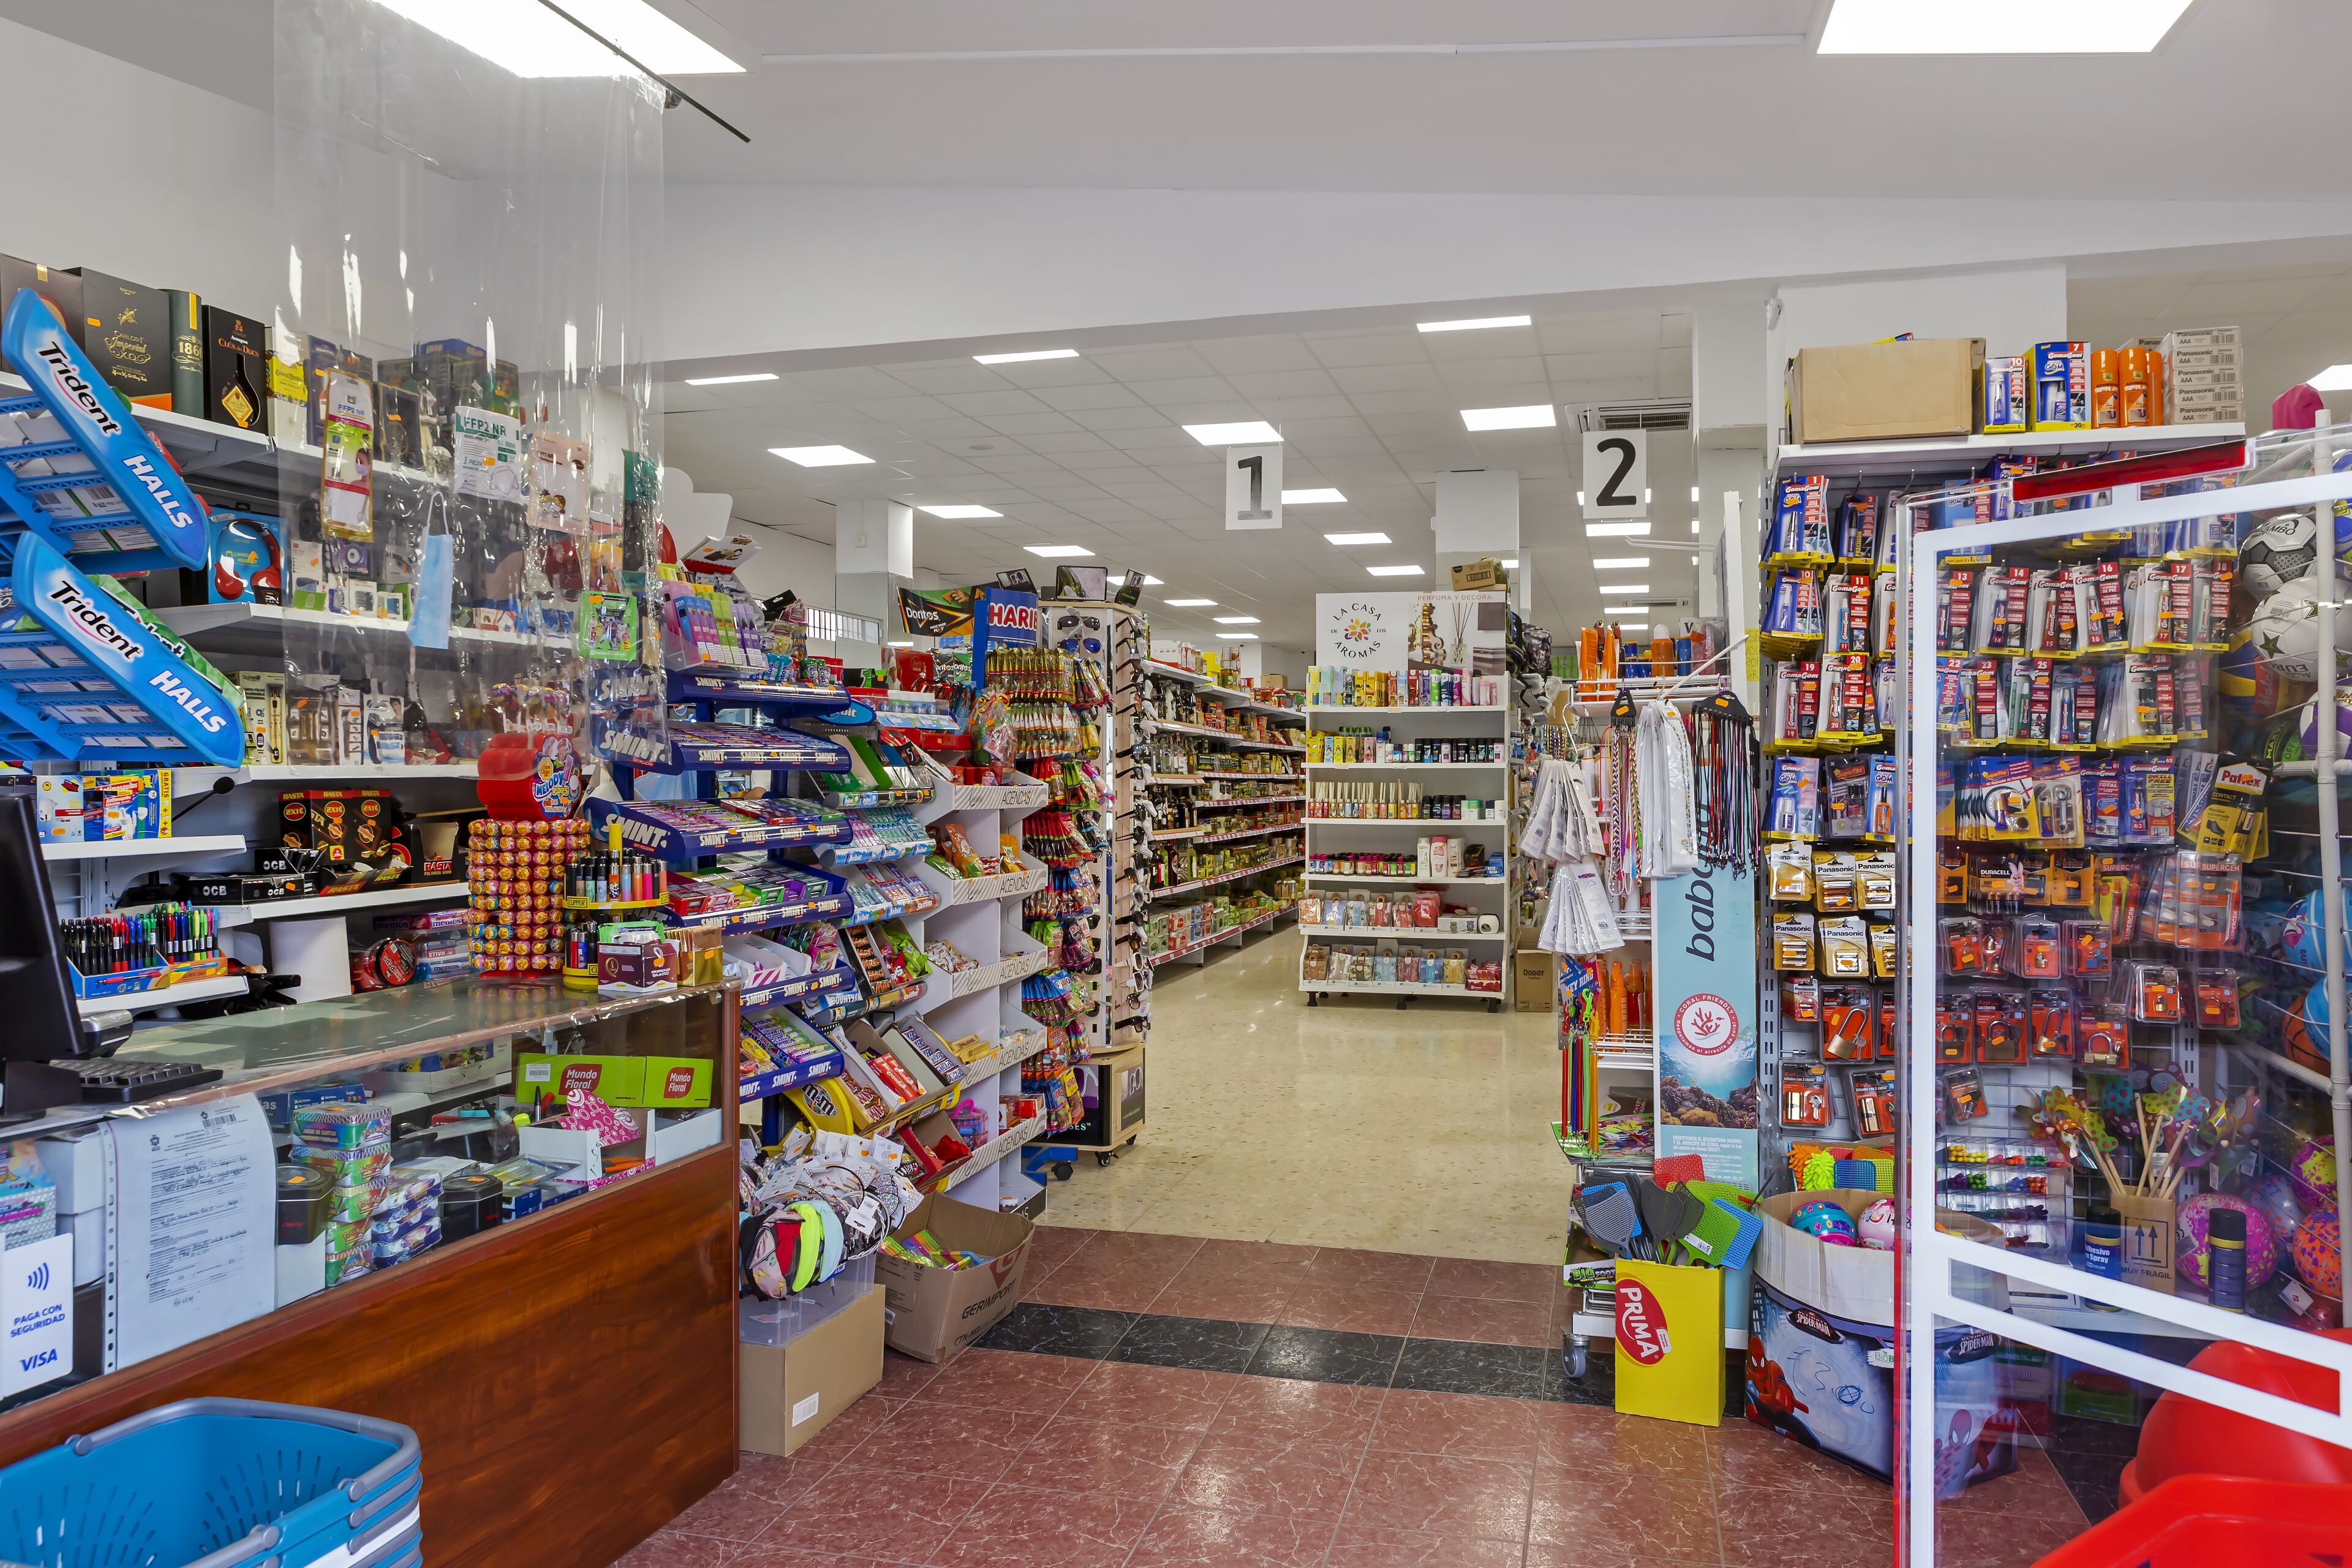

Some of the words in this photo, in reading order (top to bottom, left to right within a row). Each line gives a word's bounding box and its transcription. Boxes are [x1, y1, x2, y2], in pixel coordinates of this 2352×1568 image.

[39, 341, 121, 435] Trident
[464, 416, 489, 433] FFP2
[492, 423, 507, 437] NR
[1596, 437, 1637, 507] 2
[123, 454, 195, 529] HALLS
[1237, 455, 1273, 520] 1
[1785, 484, 1821, 493] GomaGom
[2014, 568, 2024, 577] 14
[1855, 576, 1864, 585] 11
[2076, 575, 2118, 584] GomaGom
[1333, 608, 1348, 621] LA
[1351, 603, 1382, 621] CASA
[50, 579, 142, 660] Trident
[2048, 604, 2056, 636] GomaGom
[1334, 640, 1381, 659] AROMAS
[1850, 655, 1861, 664] 20
[1948, 659, 1961, 668] 22
[1805, 663, 1815, 671] 19
[148, 669, 228, 733] HALLS
[600, 731, 665, 762] SMINT
[1838, 768, 1863, 777] SuperTite
[1986, 769, 2007, 778] SuperTite
[535, 772, 565, 796] MELODY
[552, 786, 570, 795] POPS
[2212, 791, 2237, 800] CONTACT
[742, 831, 766, 842] SMINT
[780, 827, 802, 839] SMINT
[699, 834, 726, 846] SMINT
[263, 860, 286, 870] OCB
[424, 861, 452, 871] RASTA
[203, 885, 227, 896] OCB
[327, 884, 360, 894] RASTA
[568, 898, 586, 907] CLIPPER
[377, 920, 409, 929] mentos
[432, 918, 462, 927] mentos
[2124, 907, 2135, 940] SUPERGEN
[1000, 956, 1030, 978] AGENDAS
[820, 975, 840, 987] SMINT
[1566, 981, 1579, 992] KEY
[1579, 971, 1594, 987] RING
[784, 983, 805, 996] SMINT
[832, 993, 854, 1004] BOUNTY
[1679, 995, 1700, 1013] CORAL
[1703, 995, 1735, 1014] FRIENDLY
[1676, 1019, 1696, 1051] Respetamos
[1704, 1044, 1727, 1054] arrecife
[999, 1042, 1028, 1066] AGENDAS
[567, 1068, 598, 1080] Mundo
[808, 1063, 830, 1077] SMINT
[565, 1077, 592, 1090] Floral
[669, 1074, 692, 1084] Mundo
[772, 1072, 795, 1087] SMINT
[669, 1083, 688, 1093] Floral
[998, 1127, 1028, 1156] AGENDAS
[2090, 1253, 2108, 1264] Spray
[2121, 1266, 2138, 1276] MUY
[962, 1278, 1017, 1319] GERIMPORT
[13, 1311, 39, 1326] PAGA
[42, 1303, 62, 1317] CON
[10, 1313, 66, 1338] SEGURIDAD
[1619, 1287, 1659, 1358] PRIMA
[1796, 1313, 1831, 1337] SPIDER-MAN
[1959, 1334, 1994, 1355] SPIDER-MAN
[20, 1348, 58, 1373] VISA
